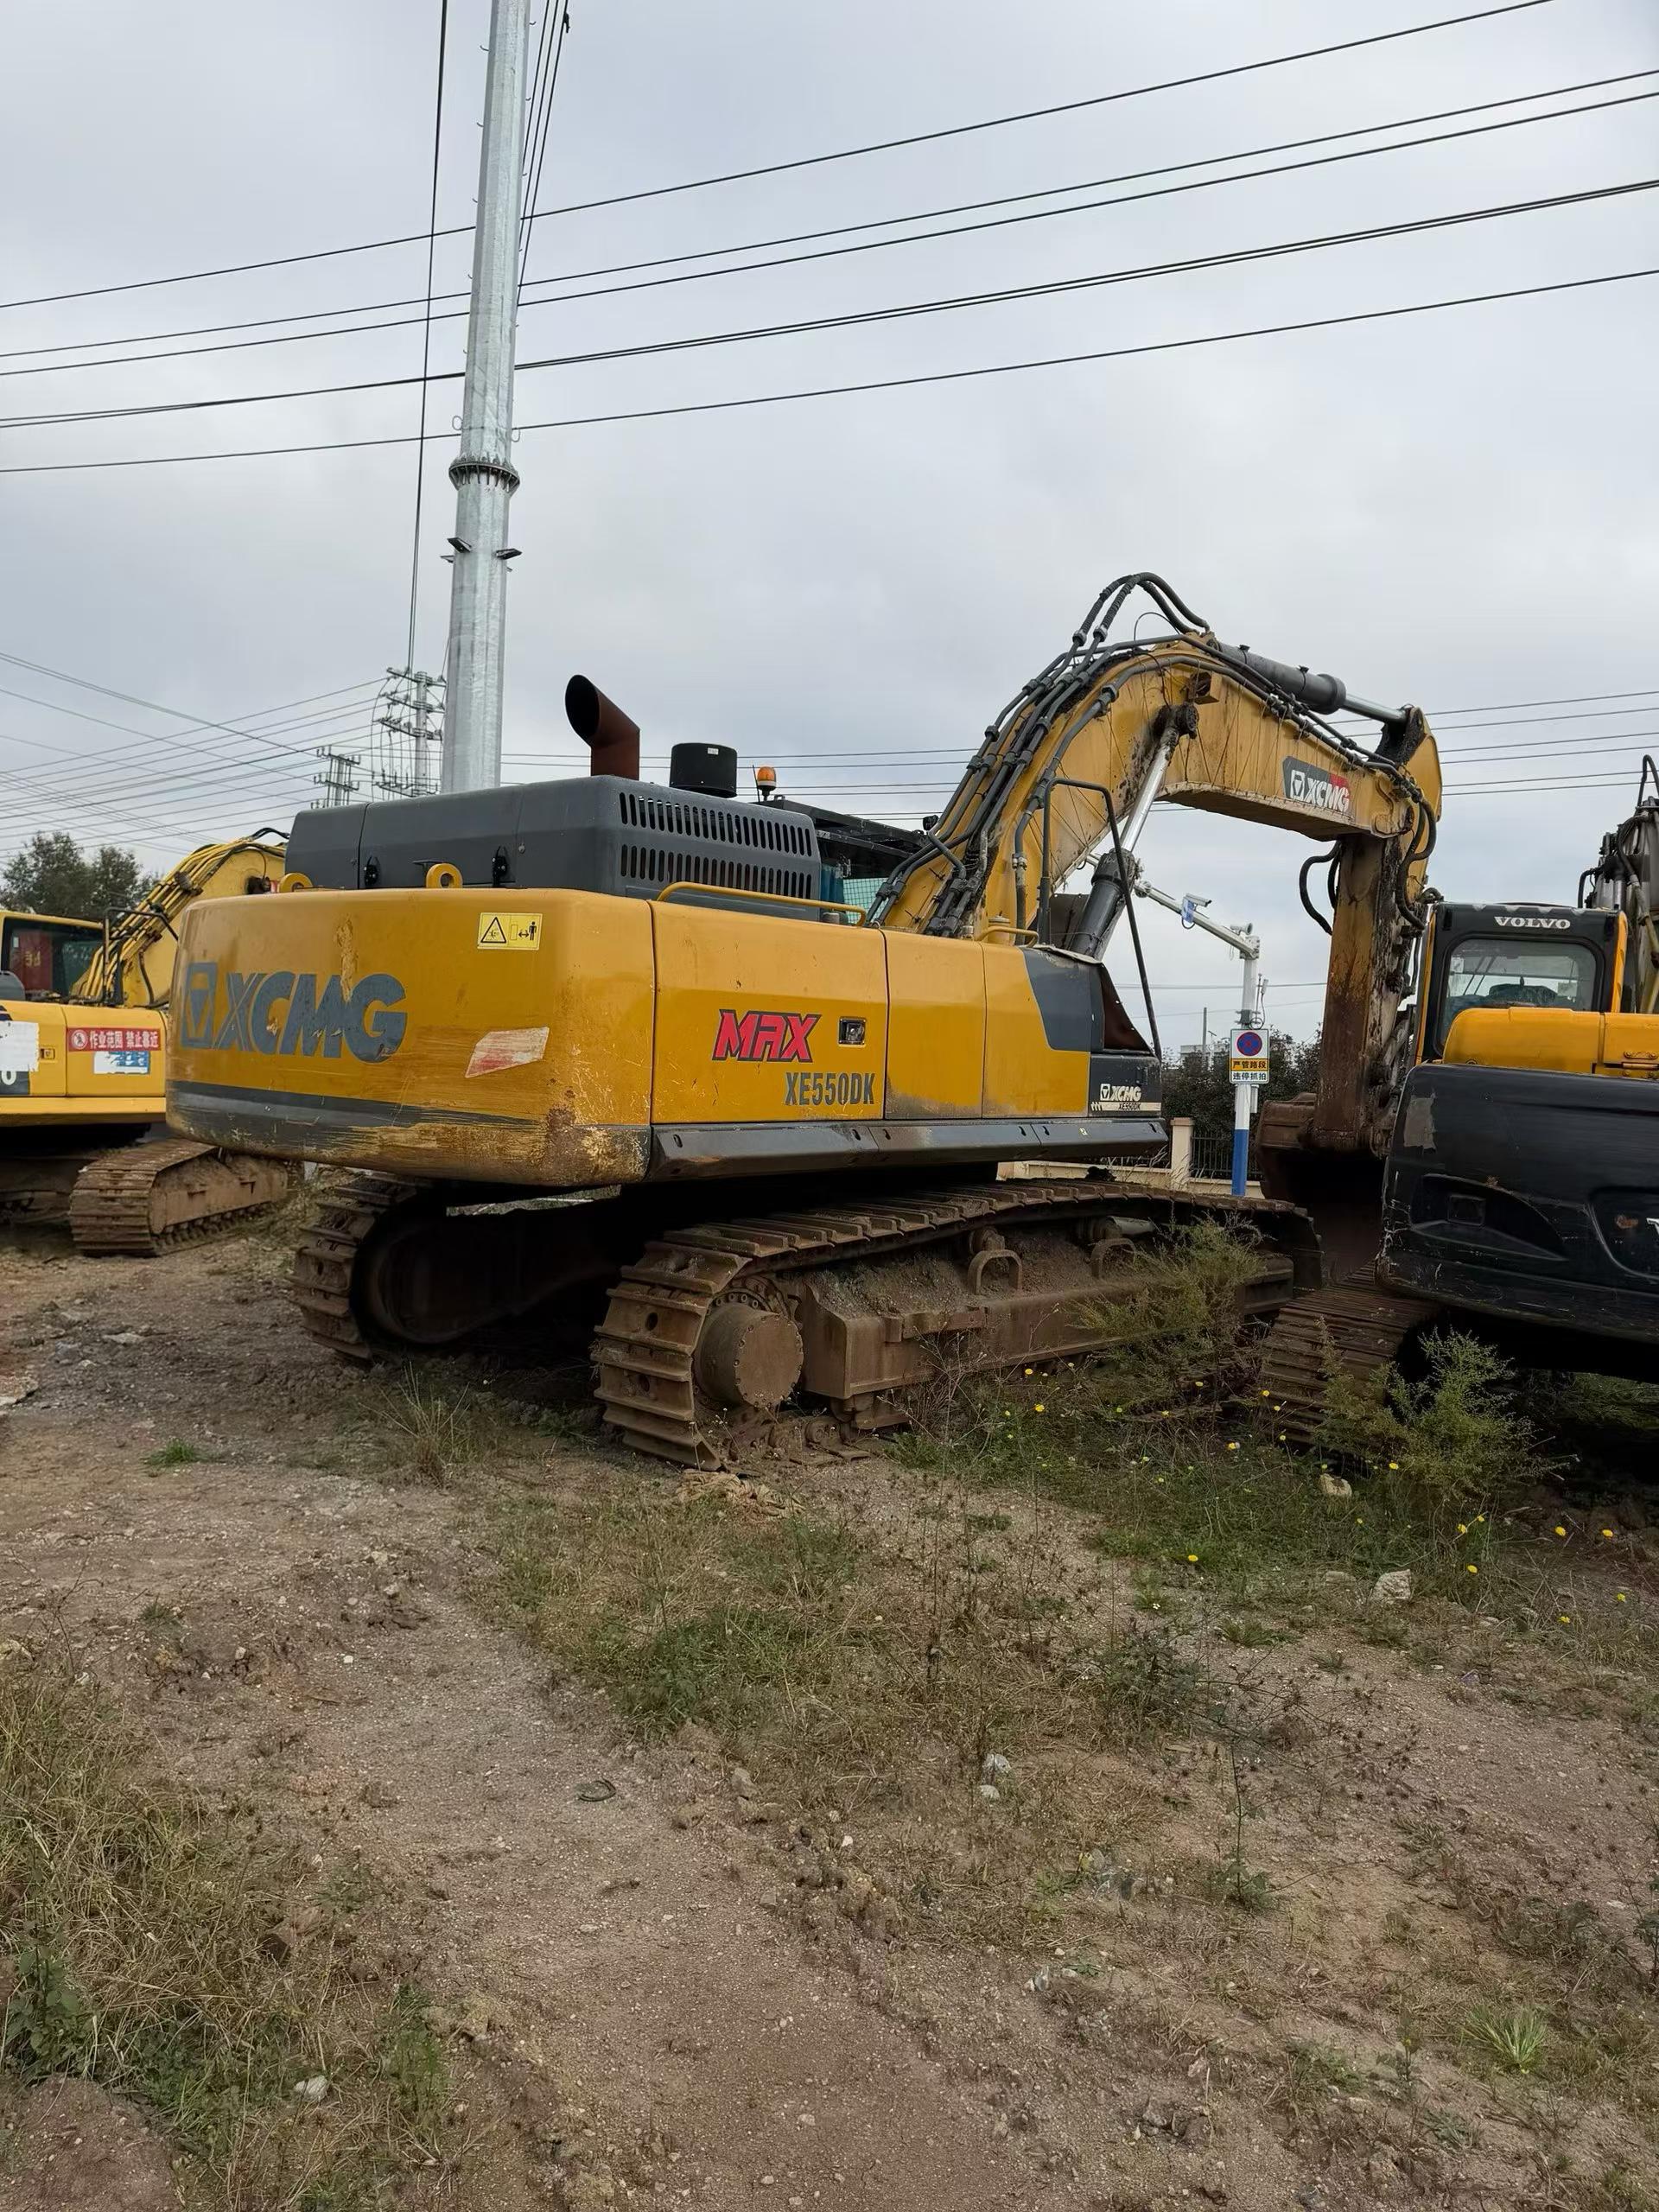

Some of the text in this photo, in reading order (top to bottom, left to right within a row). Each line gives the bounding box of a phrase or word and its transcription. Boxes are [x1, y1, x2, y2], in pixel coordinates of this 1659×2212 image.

[1303, 777, 1350, 813] XCMG
[1494, 916, 1571, 930] VOLVO
[217, 970, 408, 1065] XCMG
[712, 1008, 823, 1063] MAX
[785, 1072, 876, 1106] XE550DK
[1109, 1085, 1141, 1102] XCMG
